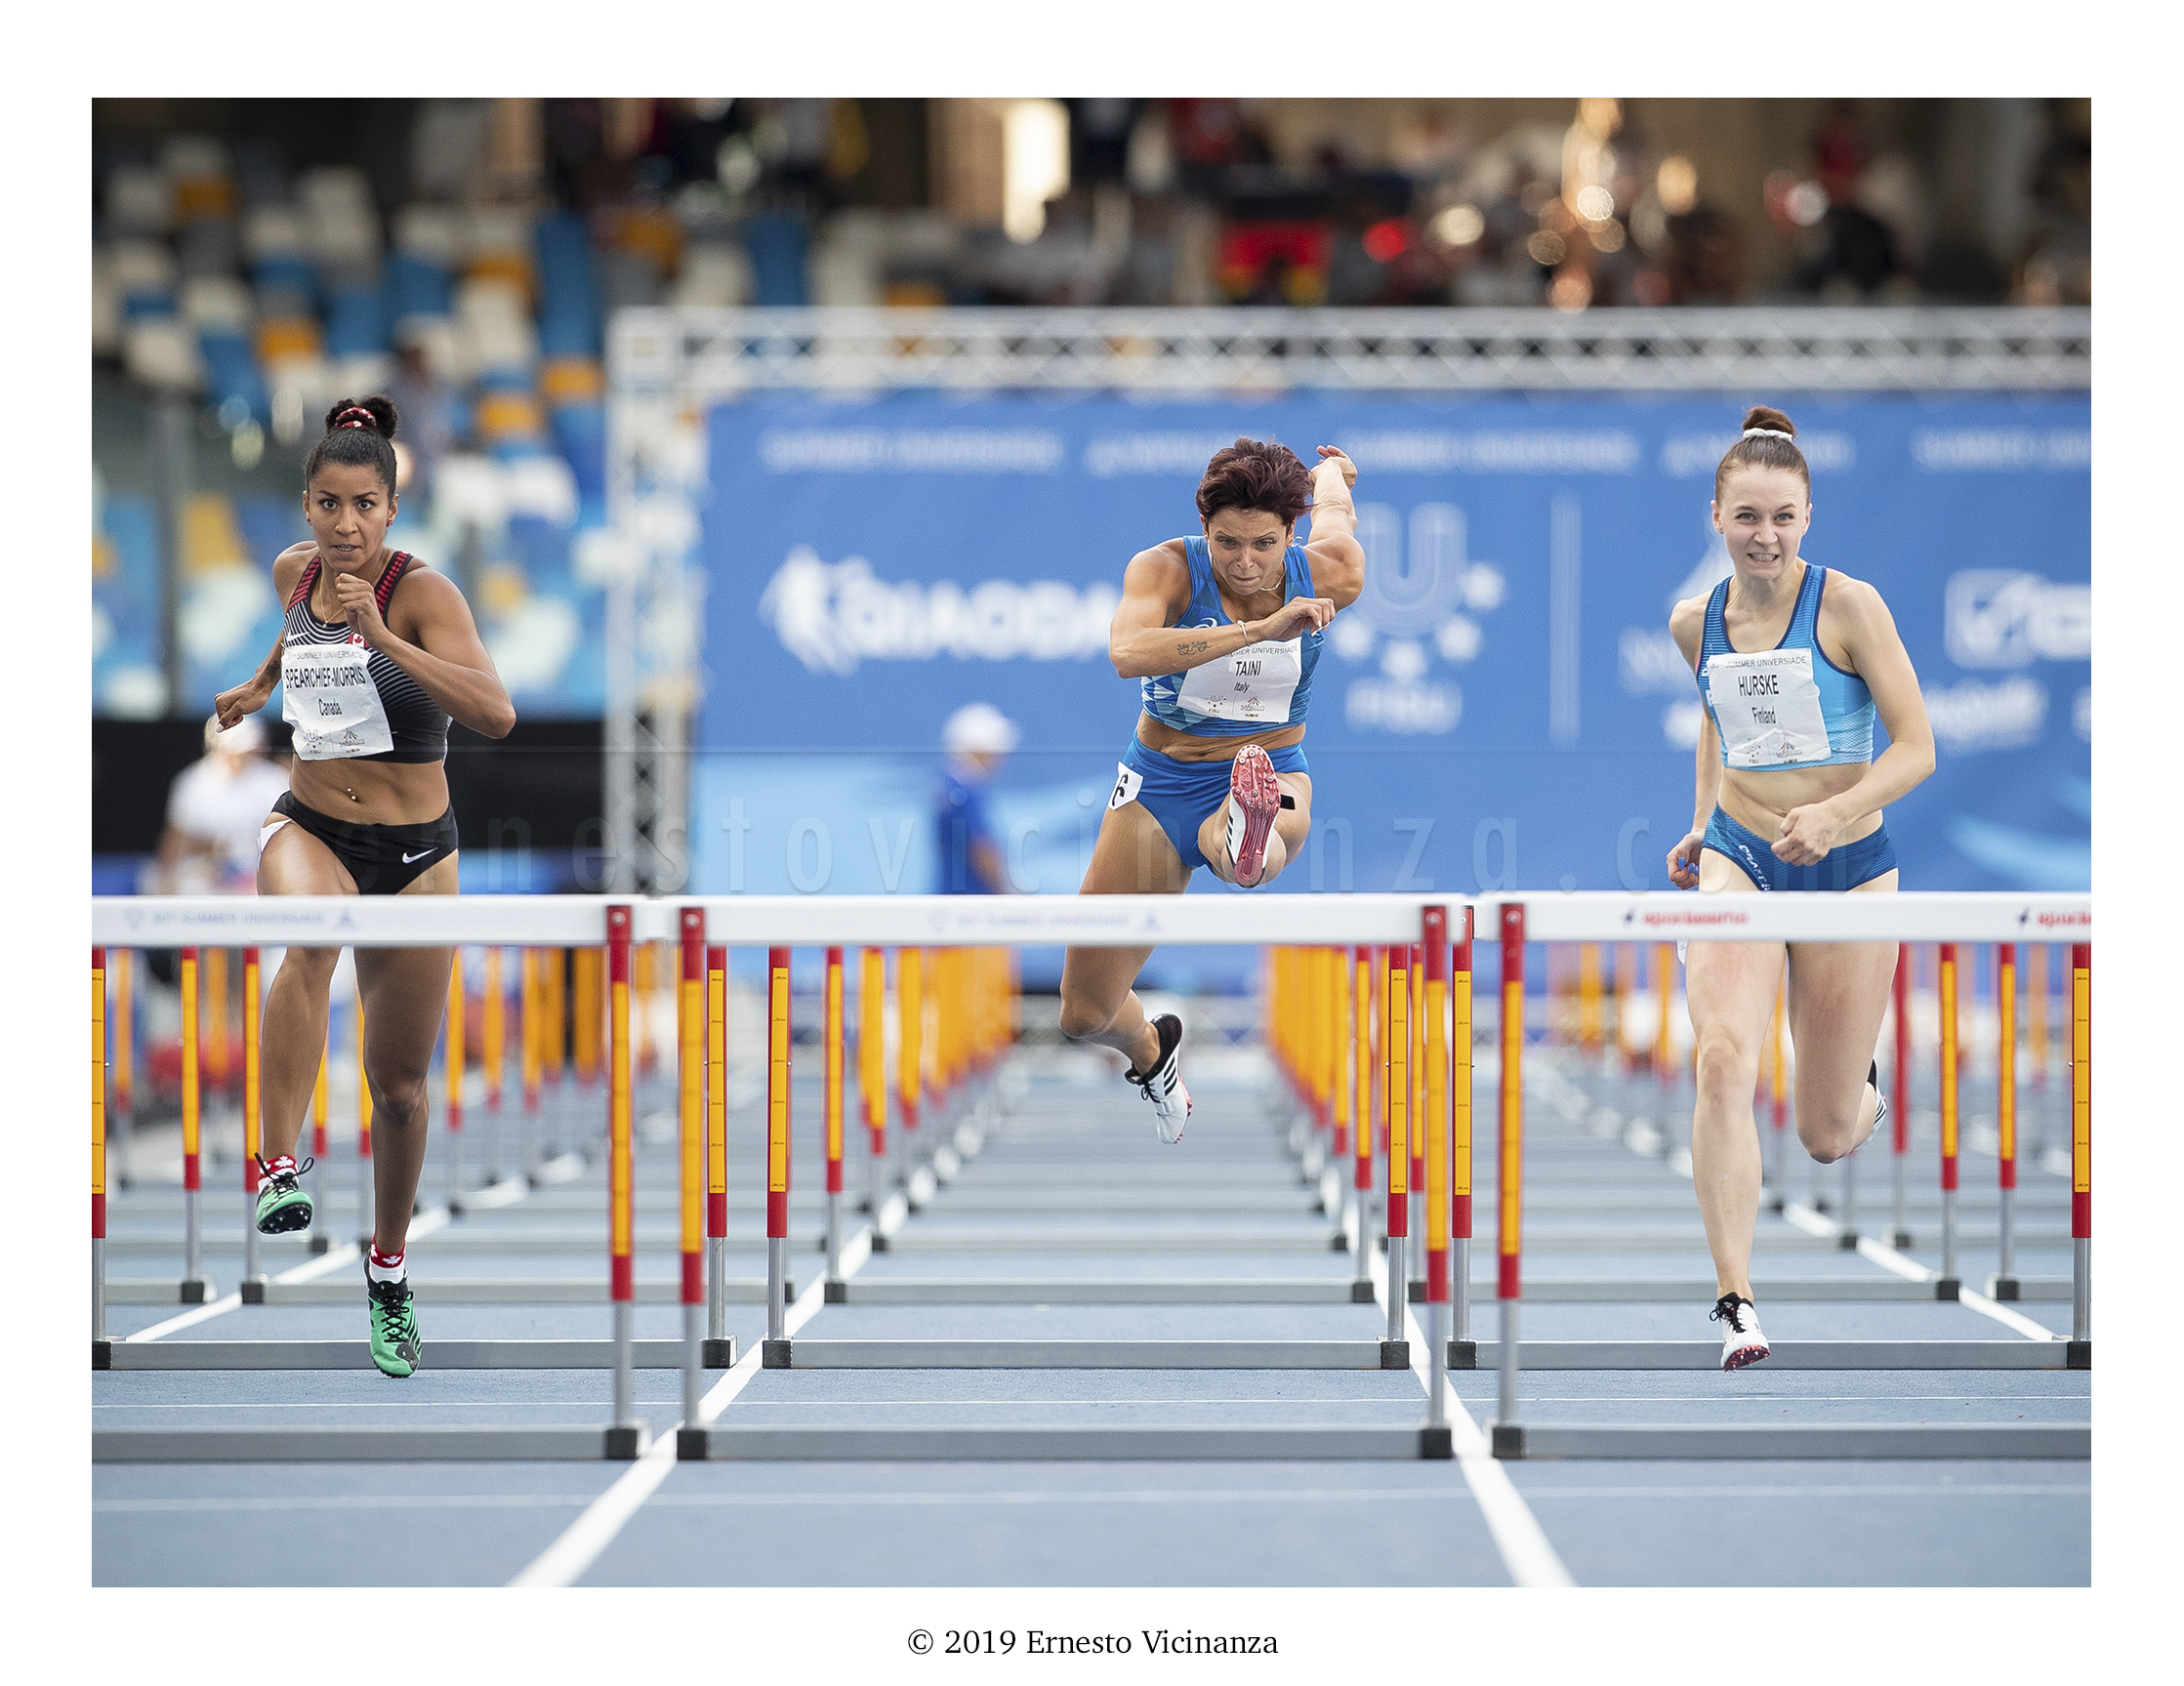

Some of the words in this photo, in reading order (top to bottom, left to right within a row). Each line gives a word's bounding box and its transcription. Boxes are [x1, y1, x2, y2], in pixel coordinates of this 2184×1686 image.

[1235, 661, 1261, 676] TAINI
[1757, 656, 1807, 667] UNIVERSIADE
[285, 666, 366, 689] SPEARCHIEF-MORRIS
[1738, 675, 1780, 696] HURSKE
[1233, 681, 1250, 693] Italy
[318, 698, 343, 716] Canada
[1751, 706, 1776, 724] Finland
